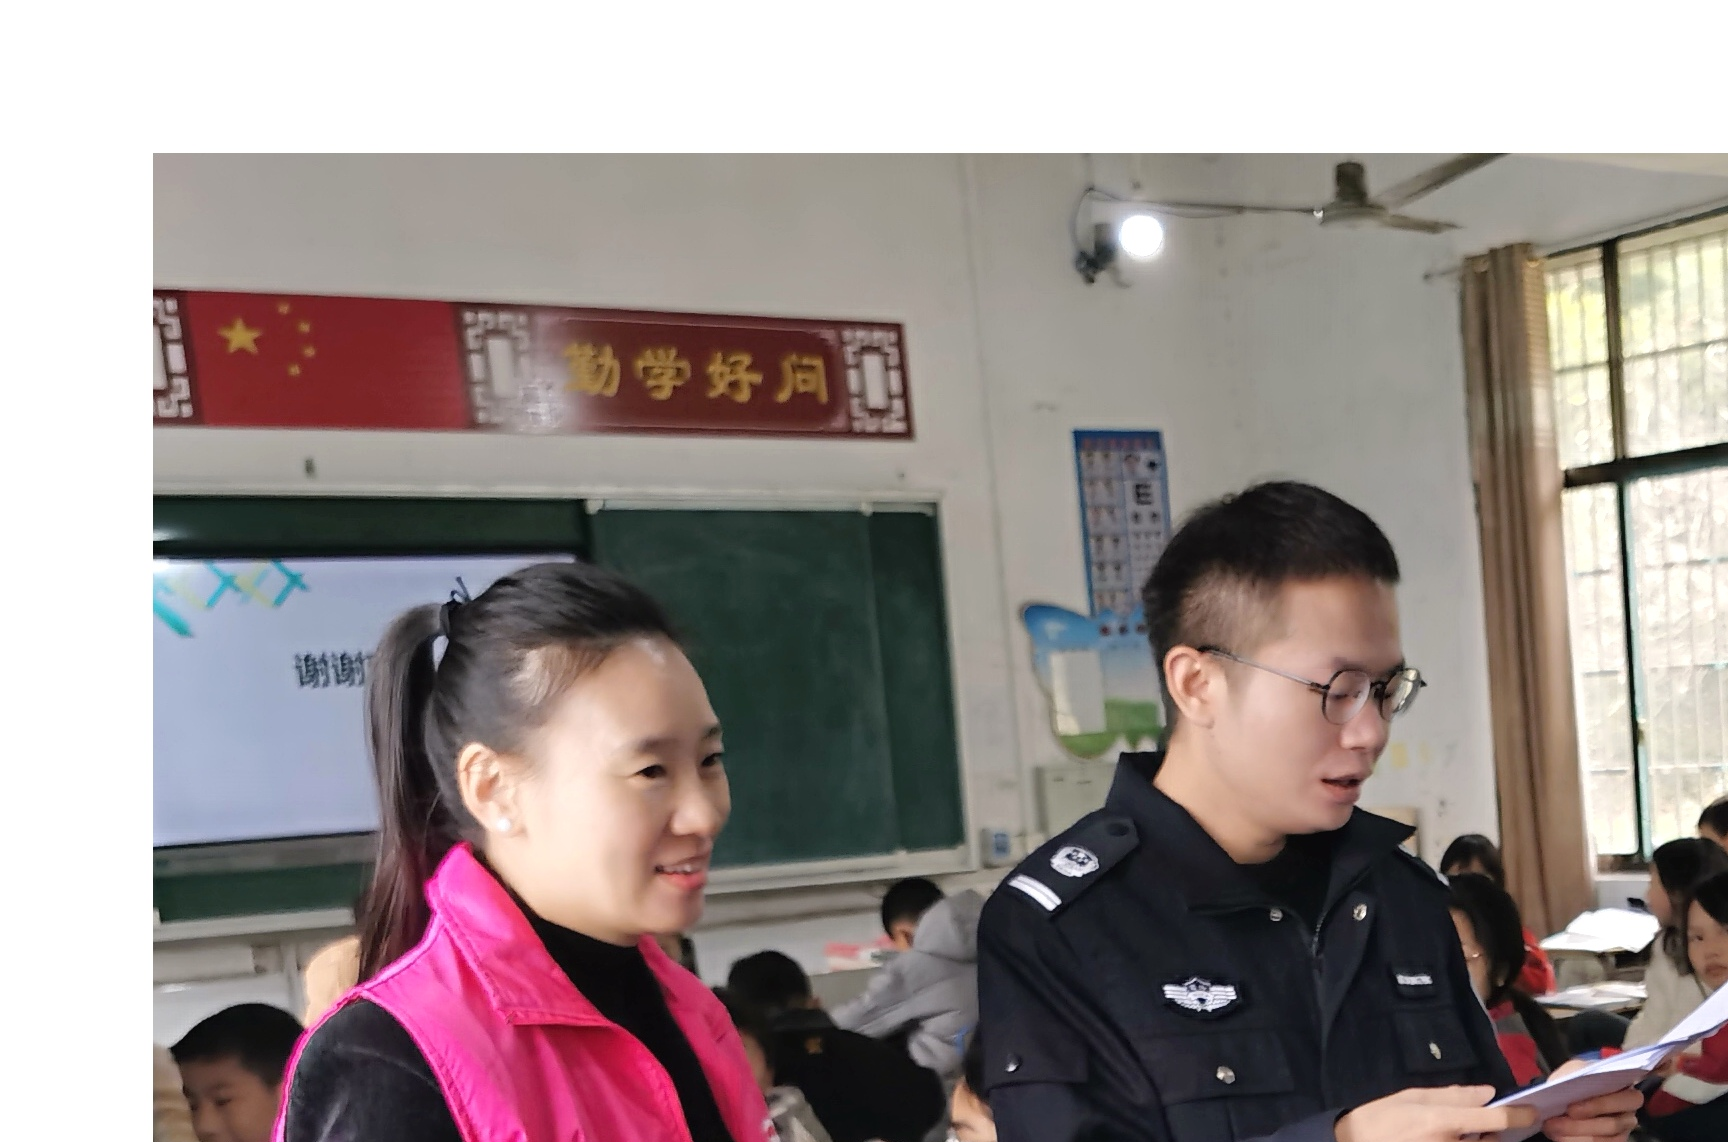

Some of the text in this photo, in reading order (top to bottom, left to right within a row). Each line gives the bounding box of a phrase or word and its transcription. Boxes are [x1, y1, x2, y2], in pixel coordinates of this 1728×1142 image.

[564, 341, 829, 405] 勤学好问
[294, 650, 373, 688] 谢谢
